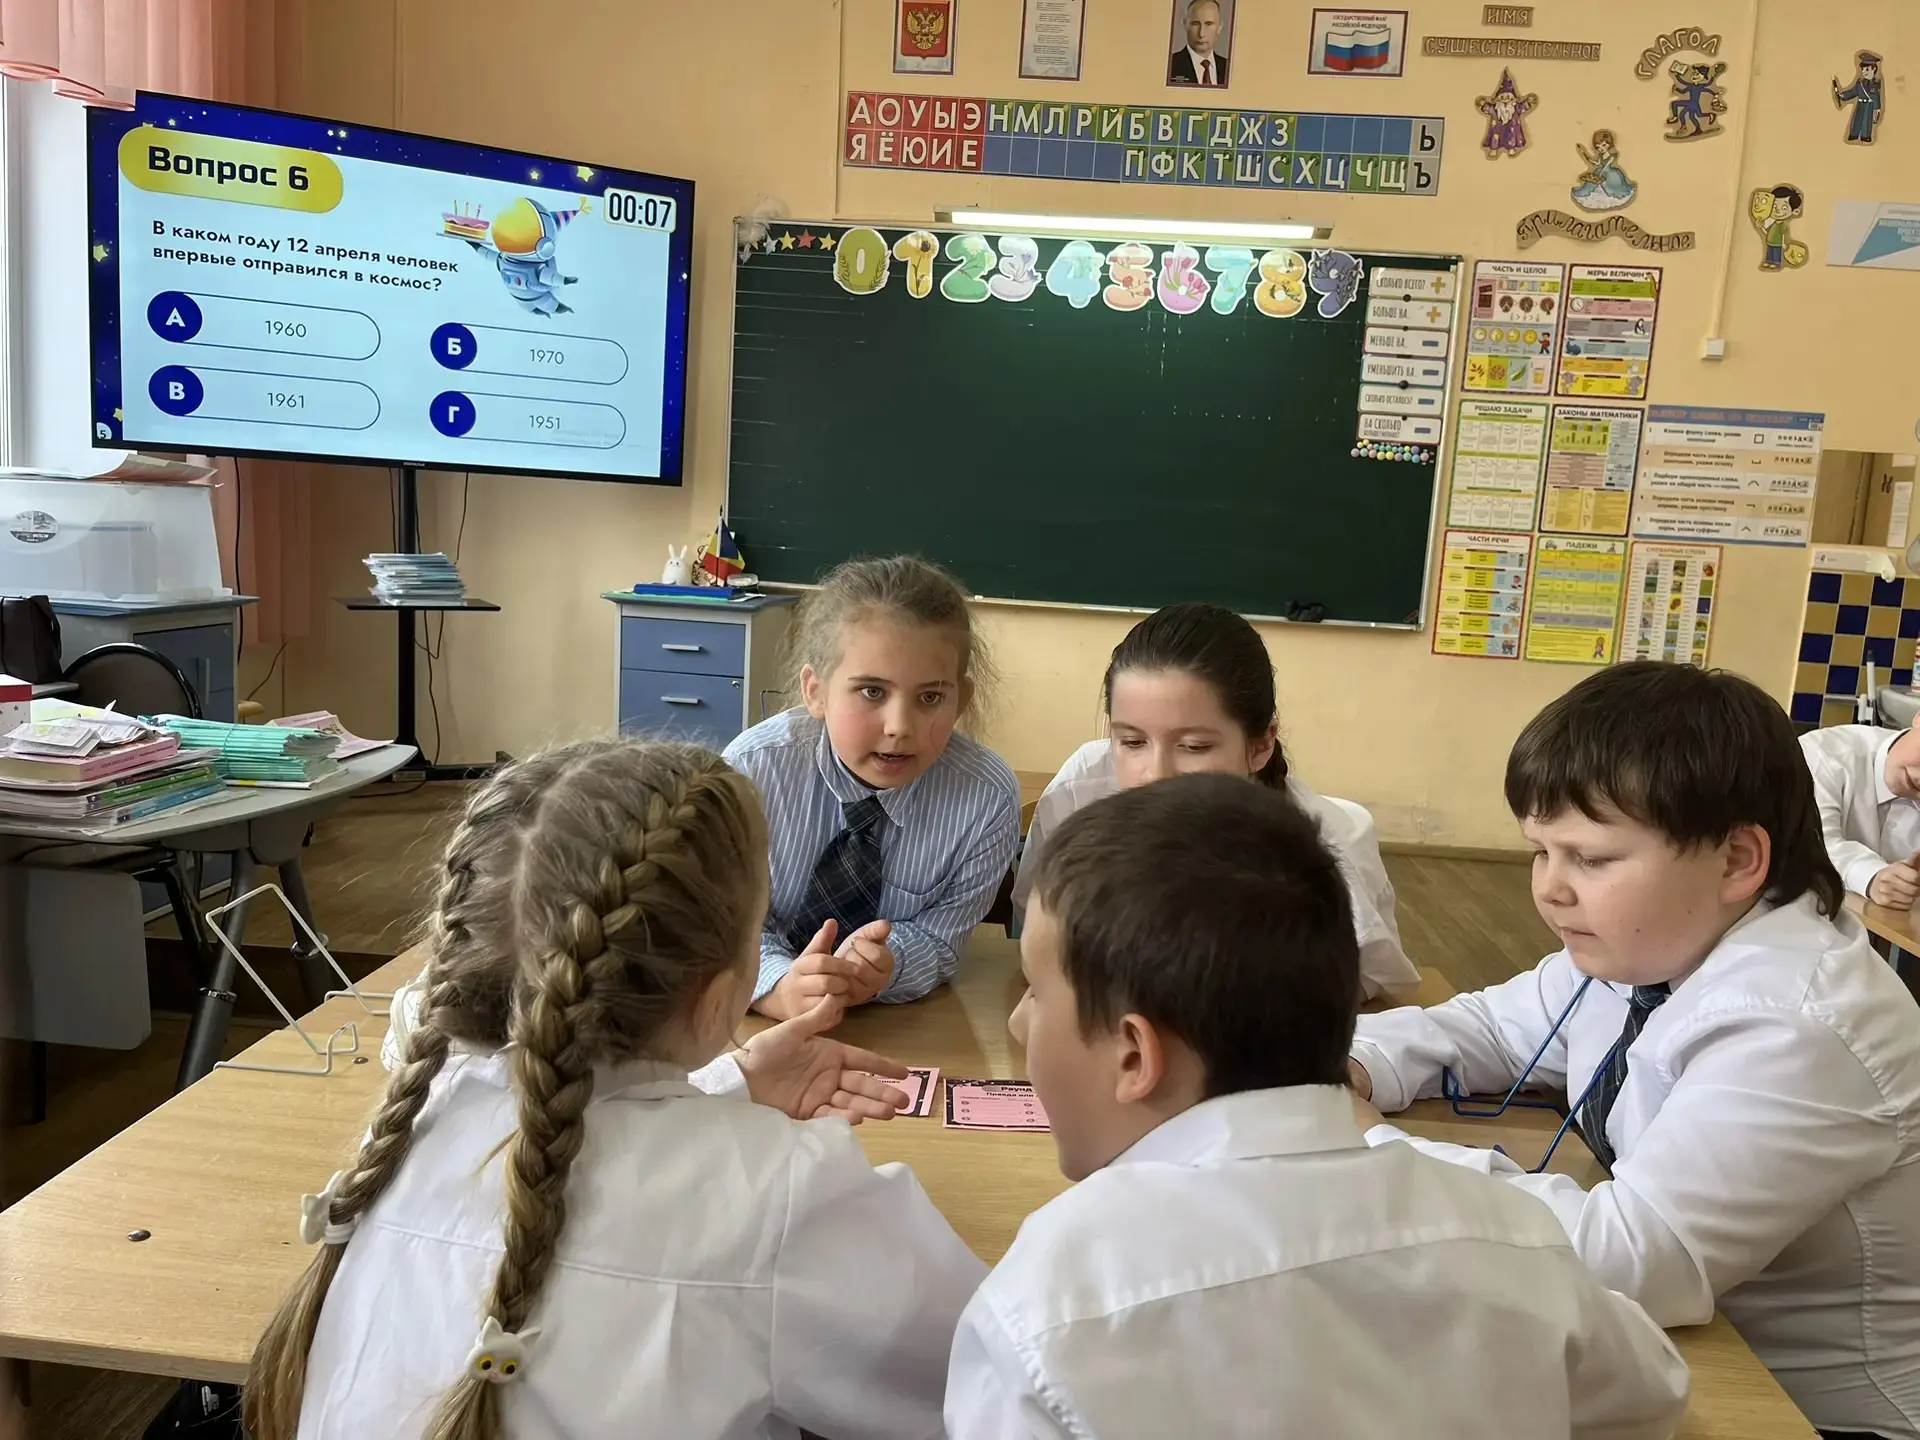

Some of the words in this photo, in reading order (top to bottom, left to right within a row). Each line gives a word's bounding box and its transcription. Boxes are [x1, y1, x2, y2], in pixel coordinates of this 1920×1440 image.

[1487, 7, 1529, 25] ИМЯ
[1424, 38, 1601, 61] СУЩЕСТВИТЕЛЬНОЕ
[1637, 30, 1718, 76] ГЛАГОЛ
[850, 98, 872, 124] А
[877, 98, 901, 127] О
[908, 99, 927, 127] У
[934, 101, 957, 130] Ы
[964, 103, 982, 131] Э
[988, 104, 1008, 133] Н
[1013, 105, 1039, 134] М
[1043, 107, 1065, 136] Л
[1076, 108, 1093, 136] Р
[1101, 108, 1123, 139] Й
[1129, 113, 1145, 140] Б
[1157, 114, 1174, 142] В
[1187, 115, 1204, 142] Г
[1210, 116, 1233, 148] Д
[1238, 117, 1264, 146] Ж
[1271, 118, 1288, 147] З
[1419, 124, 1436, 152] Ь
[148, 145, 278, 186] Вопрос
[288, 165, 309, 191] 6
[850, 134, 867, 161] Я
[878, 132, 894, 163] Ё
[902, 136, 928, 165] Ю
[932, 138, 952, 166] И
[962, 140, 978, 167] Е
[1124, 150, 1144, 177] П
[1150, 150, 1174, 178] Ф
[1182, 152, 1201, 180] К
[1212, 153, 1230, 181] Т
[1236, 154, 1262, 183] Ш
[1268, 156, 1287, 184] С
[1295, 157, 1317, 185] Х
[1324, 158, 1346, 190] Ц
[1355, 158, 1374, 187] Ч
[1380, 160, 1406, 192] Щ
[1414, 162, 1432, 189] Ъ
[609, 192, 672, 228] 00:07
[153, 220, 165, 235] В
[172, 226, 232, 244] каком
[237, 234, 281, 253] году
[287, 237, 309, 253] 12
[314, 245, 381, 262] апреля
[386, 253, 459, 273] человек
[153, 247, 237, 266] впервые
[242, 257, 348, 280] отправился
[354, 272, 364, 282] в
[369, 273, 442, 291] космос?
[834, 226, 891, 295] 0
[893, 229, 939, 299] 1
[939, 233, 997, 302] 2
[988, 234, 1042, 302] 3
[1046, 240, 1105, 308] 4
[1102, 241, 1156, 313] 5
[1157, 241, 1209, 314] 6
[1205, 245, 1257, 314] 7
[1254, 248, 1307, 318] 8
[1309, 248, 1364, 318] 9
[1491, 265, 1515, 273] ЧАСТЬ
[1516, 266, 1522, 274] И
[1523, 267, 1547, 275] ЦЕЛОЕ
[1609, 270, 1645, 278] ВЕЛИЧИН
[165, 307, 186, 328] А
[264, 320, 307, 338] 1960
[447, 337, 462, 355] Б
[529, 348, 565, 365] 1970
[168, 381, 186, 400] В
[267, 392, 305, 409] 1961
[448, 405, 460, 423] Г
[1474, 405, 1502, 414] РЕШАЮ
[1503, 406, 1533, 415] ЗАДАЧИ
[1557, 409, 1588, 418] ЗАКОНЫ
[1589, 410, 1639, 420] МАТЕМАТИКИ
[528, 415, 561, 430] 1951
[1467, 535, 1490, 543] ЧАСТИ
[1491, 536, 1510, 544] РЕЧИ
[1565, 541, 1599, 549] ПАДЕЖИ
